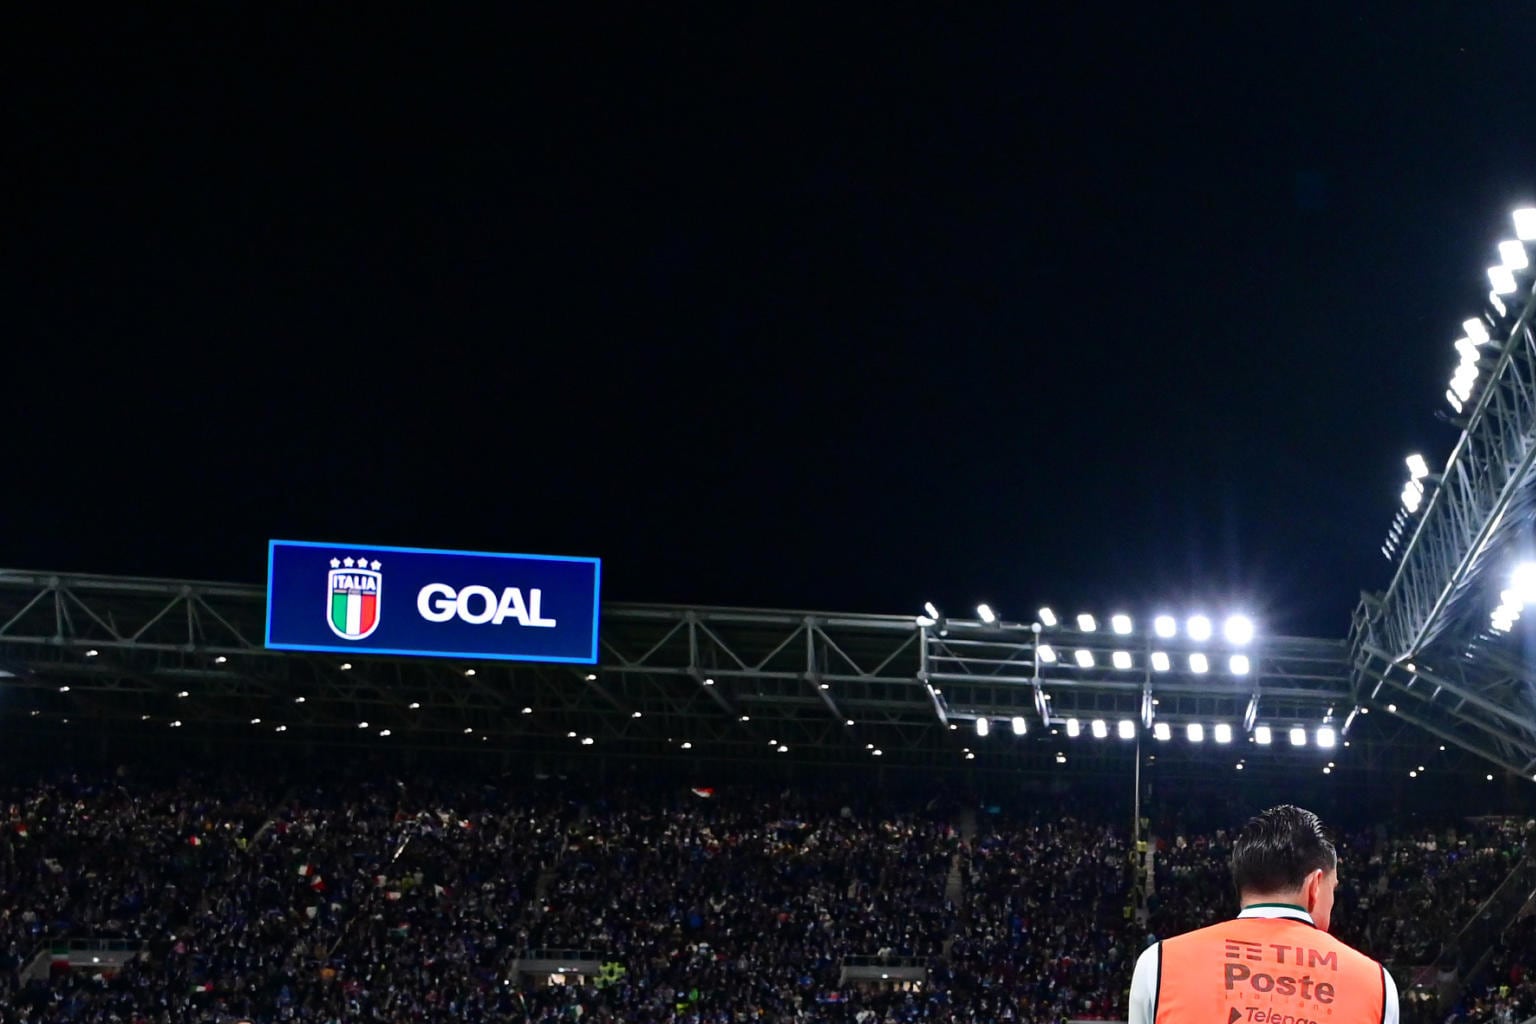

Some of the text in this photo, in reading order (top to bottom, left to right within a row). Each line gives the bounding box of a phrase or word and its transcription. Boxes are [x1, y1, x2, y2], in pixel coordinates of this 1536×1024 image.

[333, 575, 377, 590] ITALIA
[417, 583, 556, 627] GOAL
[1269, 944, 1338, 971] TIM
[1224, 963, 1335, 1004] Poste
[1225, 992, 1333, 1016] italn
